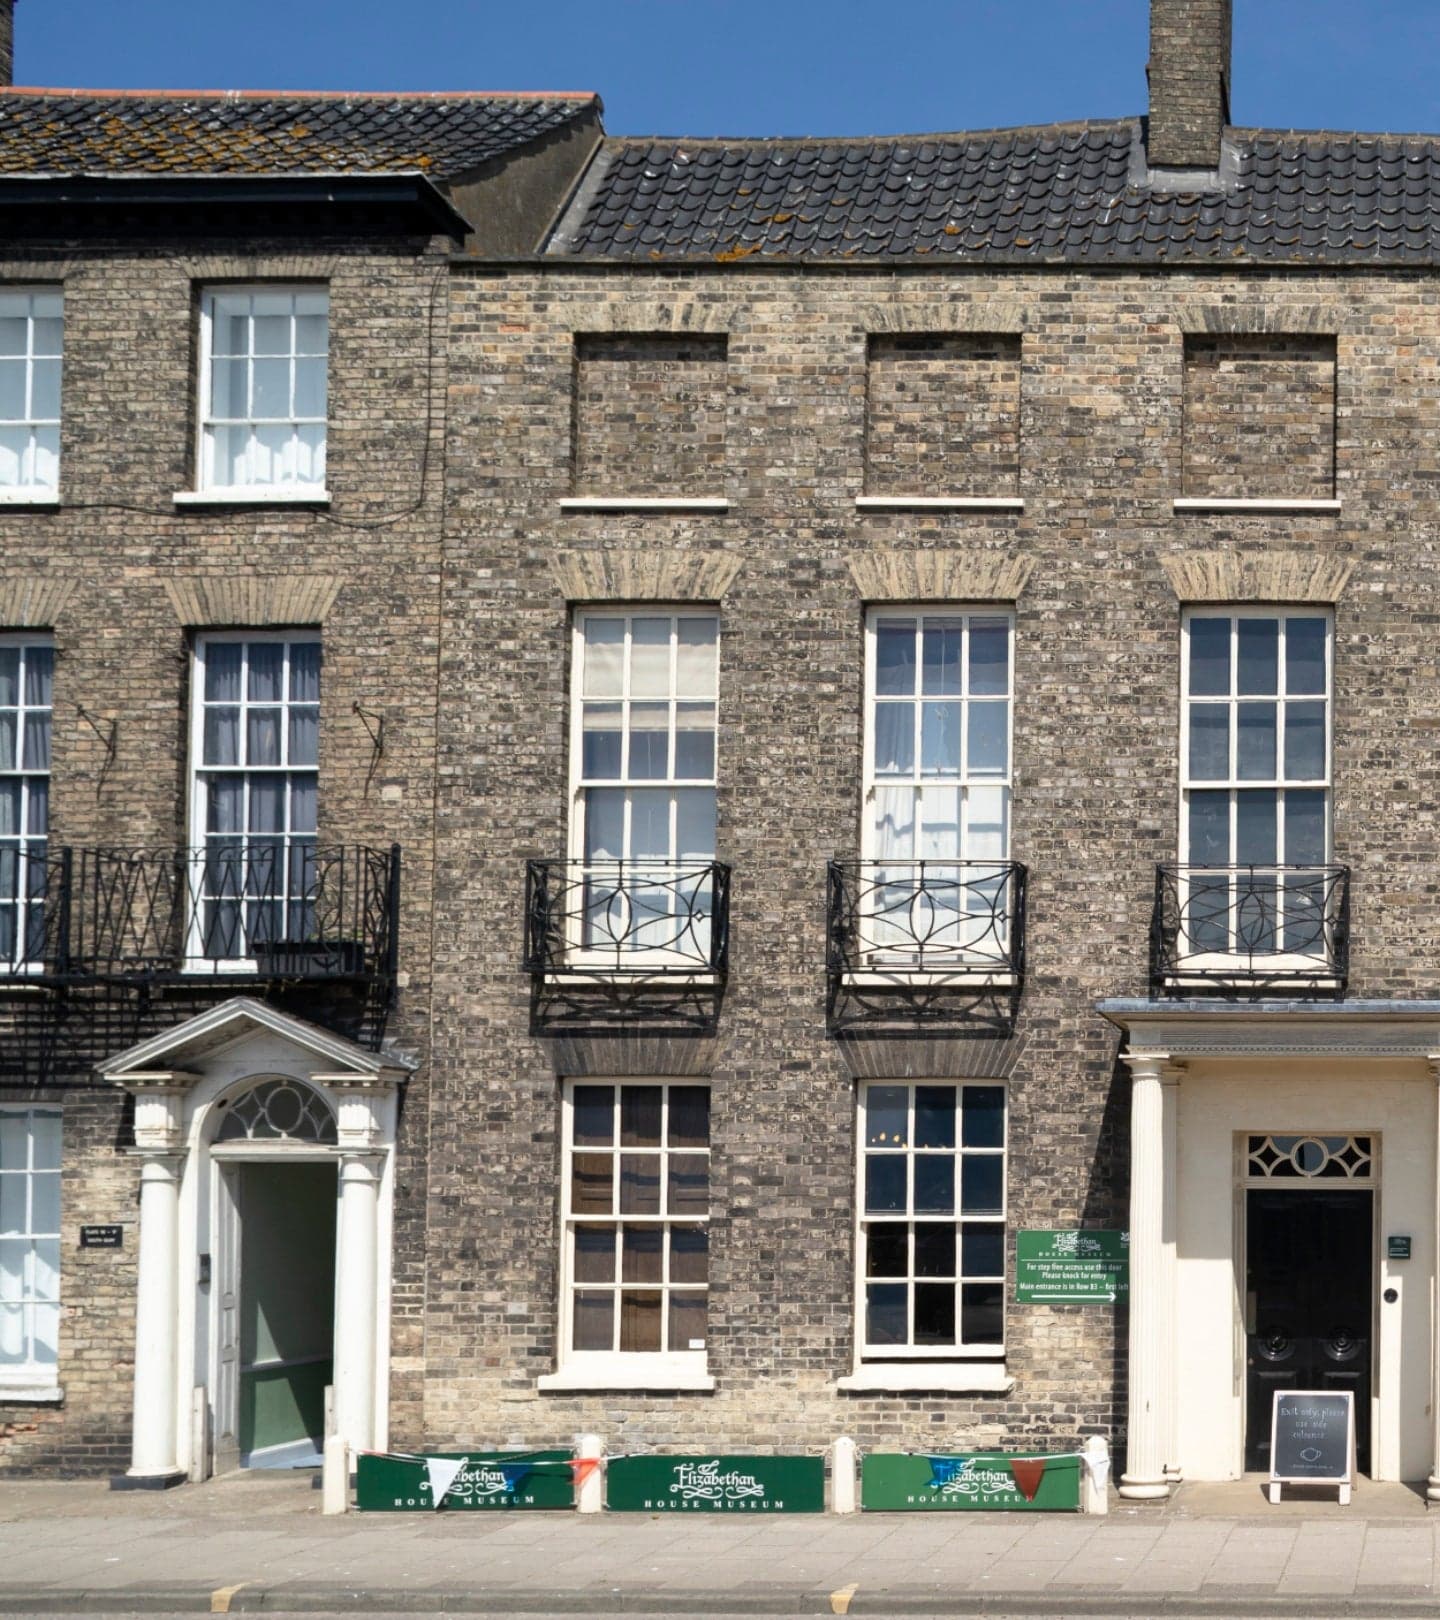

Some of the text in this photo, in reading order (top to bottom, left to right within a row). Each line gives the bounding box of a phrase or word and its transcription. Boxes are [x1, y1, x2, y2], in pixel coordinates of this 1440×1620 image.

[1038, 1263, 1050, 1273] step
[1281, 1406, 1299, 1416] Exit
[669, 1460, 764, 1499] Elizabethan
[394, 1495, 535, 1506] HOUE MUSEUM
[907, 1495, 958, 1503] HOUSE
[644, 1500, 784, 1509] HOUSE MUSEUM
